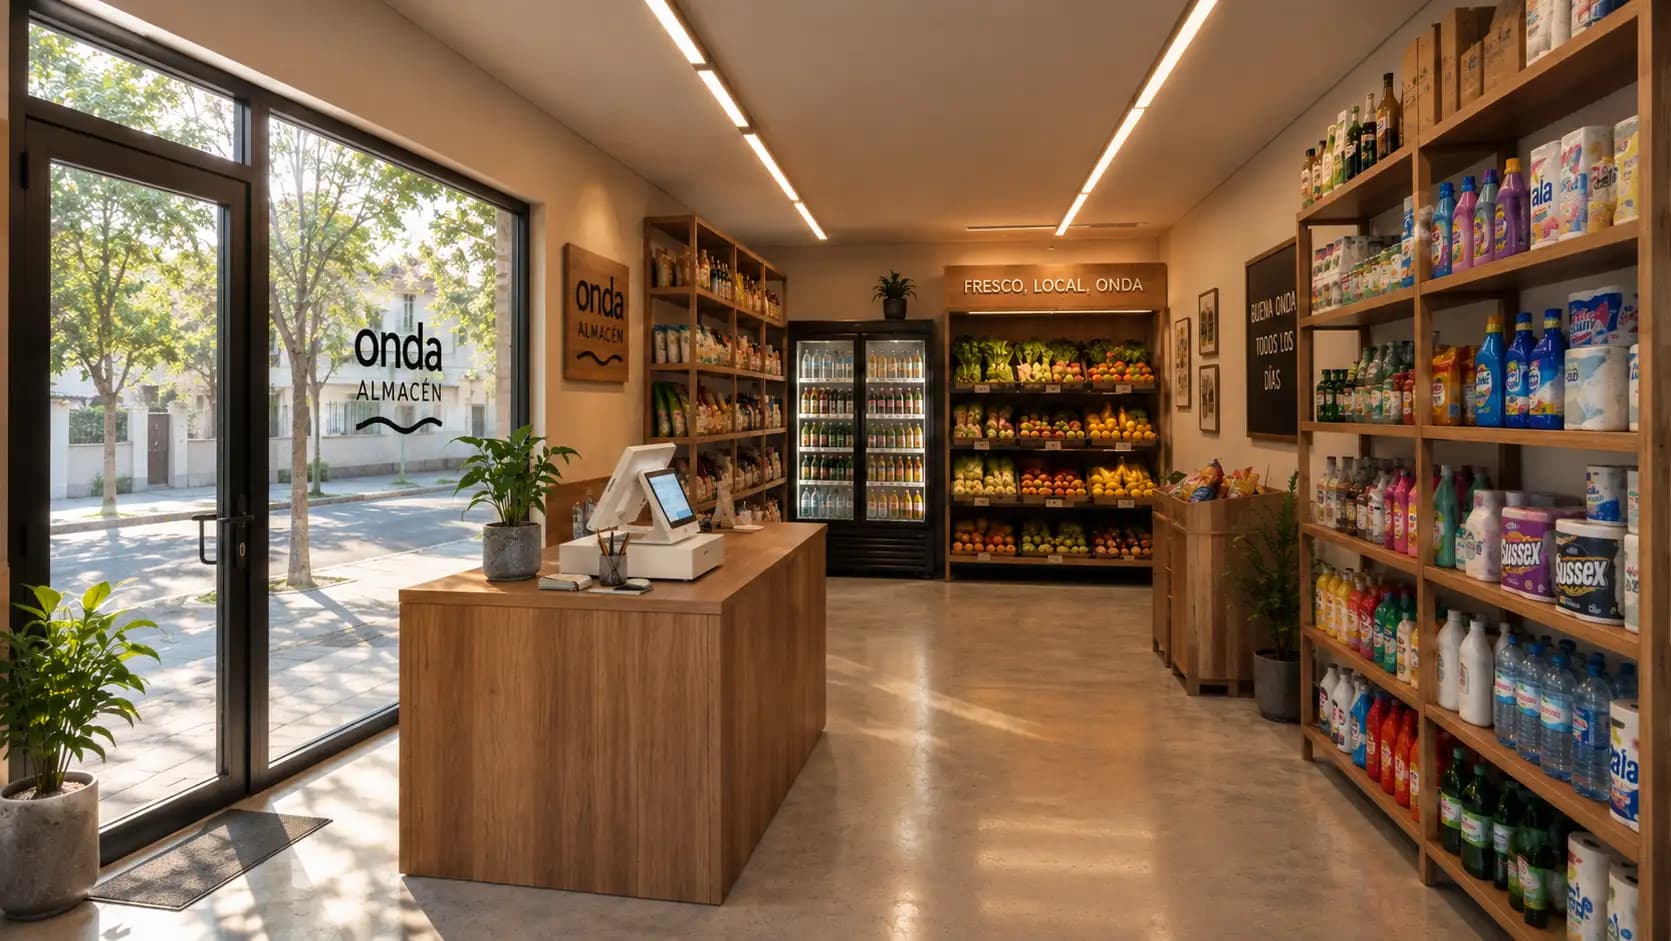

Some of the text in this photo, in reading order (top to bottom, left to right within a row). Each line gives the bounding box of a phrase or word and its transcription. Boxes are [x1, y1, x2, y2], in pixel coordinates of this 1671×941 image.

[576, 276, 624, 320] onda
[964, 277, 1144, 295] FRESCO, LOCAL, ONDA
[1251, 291, 1297, 323] BUENA ONDA
[577, 320, 624, 344] ALMACÉN
[1255, 330, 1294, 357] TODOS LOS
[355, 321, 443, 371] onda
[356, 377, 442, 402] ALMACÉN
[1264, 364, 1281, 391] DÍAS
[1500, 539, 1543, 567] Sussex
[1555, 553, 1608, 587] Sussex
